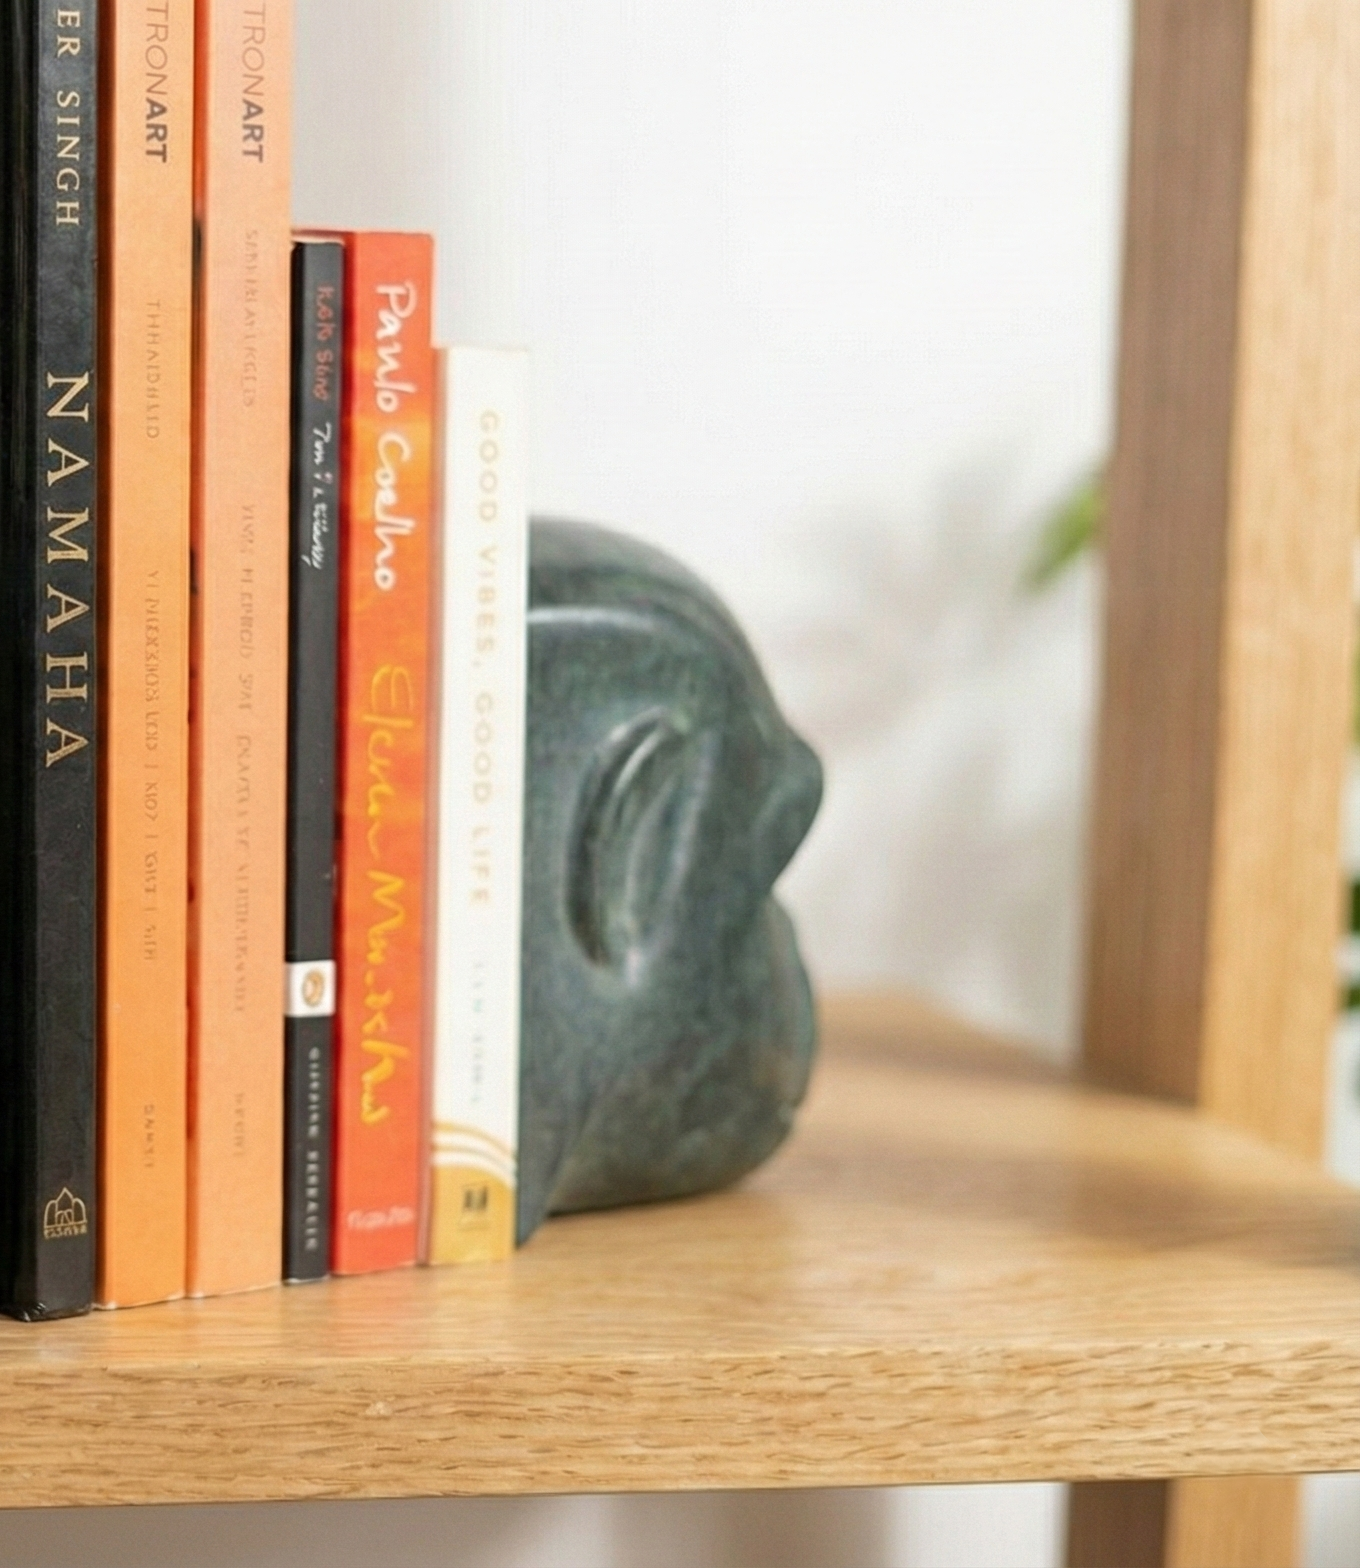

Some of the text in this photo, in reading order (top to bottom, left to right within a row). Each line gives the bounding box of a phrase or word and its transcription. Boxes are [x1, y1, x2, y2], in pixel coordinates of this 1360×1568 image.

[56, 90, 81, 226] SINGH
[145, 1, 169, 164] TRONART
[241, 2, 266, 163] TRONART
[373, 281, 417, 591] Paulo Coelho
[47, 371, 90, 768] NAMAHA
[470, 410, 499, 905] GOOD VIBES, GOOD LIFE
